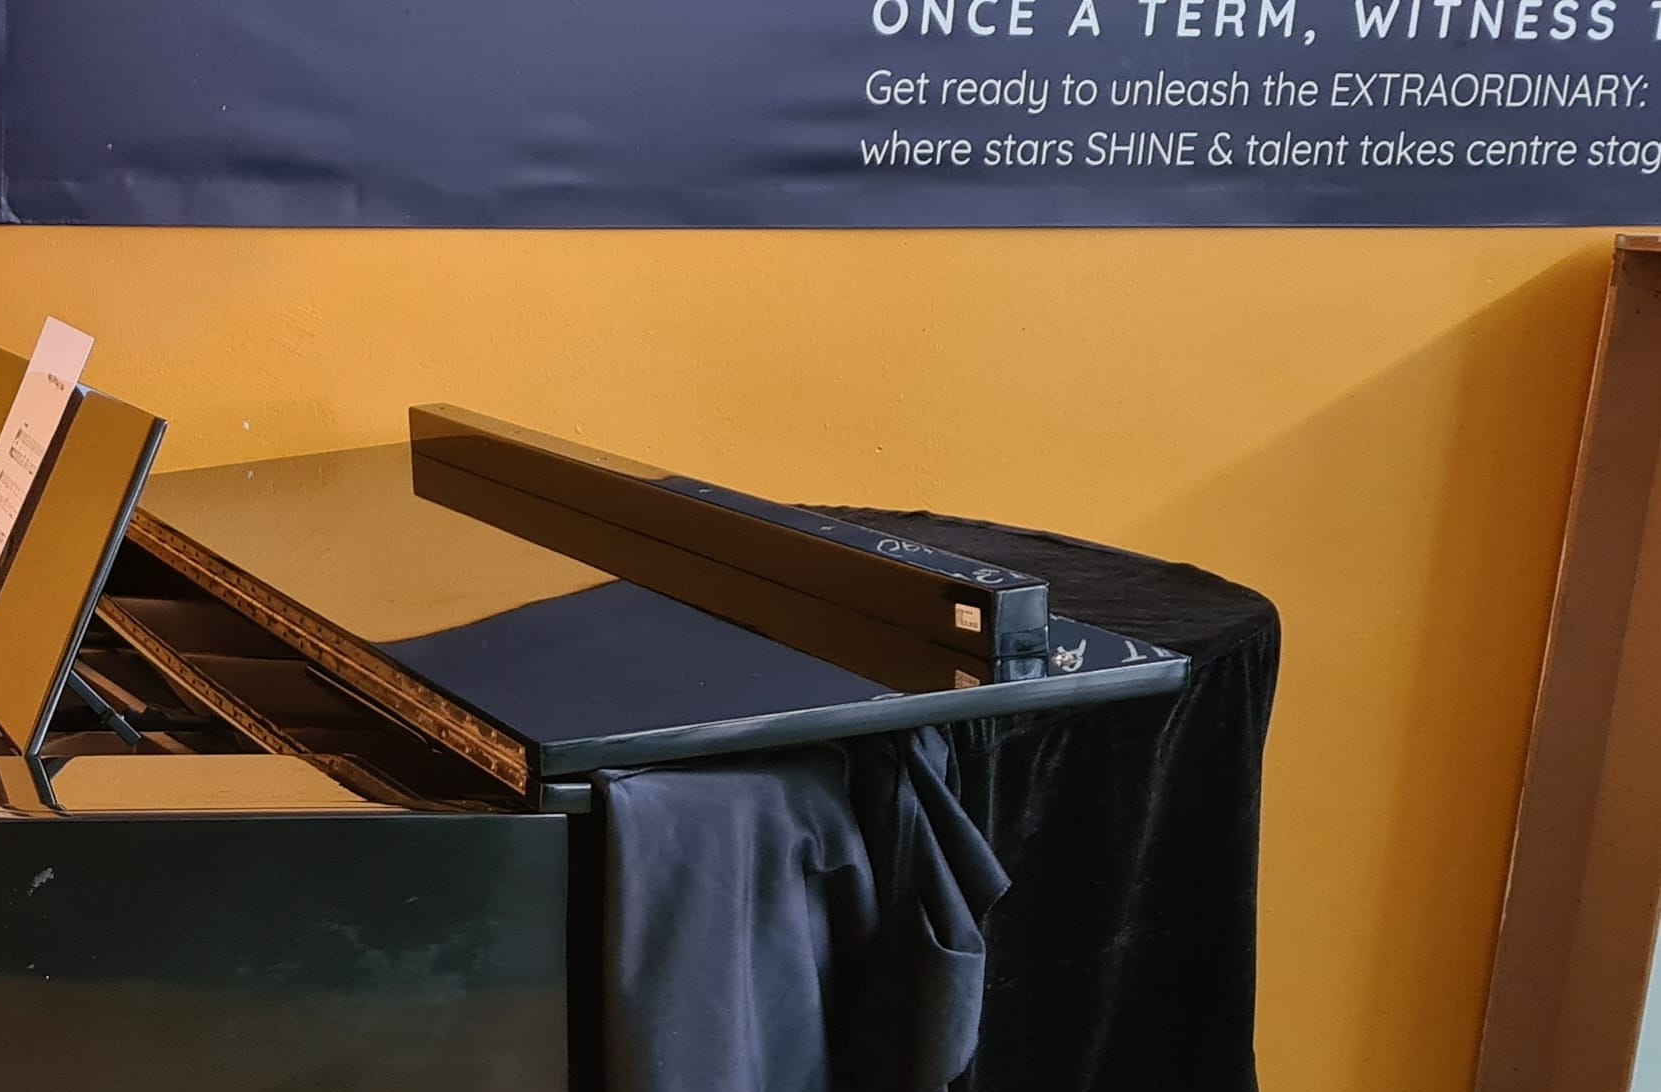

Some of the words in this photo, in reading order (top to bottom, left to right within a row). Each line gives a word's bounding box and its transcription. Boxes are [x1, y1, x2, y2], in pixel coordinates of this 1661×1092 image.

[871, 0, 1036, 36] ONCE
[1068, 0, 1100, 36] A
[1137, 0, 1316, 46] TERM,
[1355, 0, 1617, 40] WITNESS
[864, 69, 930, 105] Get
[940, 70, 1049, 113] ready
[1060, 73, 1098, 106] to
[1110, 70, 1249, 106] unleash
[1261, 71, 1319, 106] the
[1330, 73, 1649, 107] EXTRAORDINARY:
[859, 129, 972, 166] where
[982, 134, 1074, 166] stars
[1084, 131, 1198, 166] SHINE
[1206, 132, 1233, 166] &
[1245, 131, 1349, 166] talent
[1359, 131, 1455, 166] takes
[1465, 135, 1577, 166] centre
